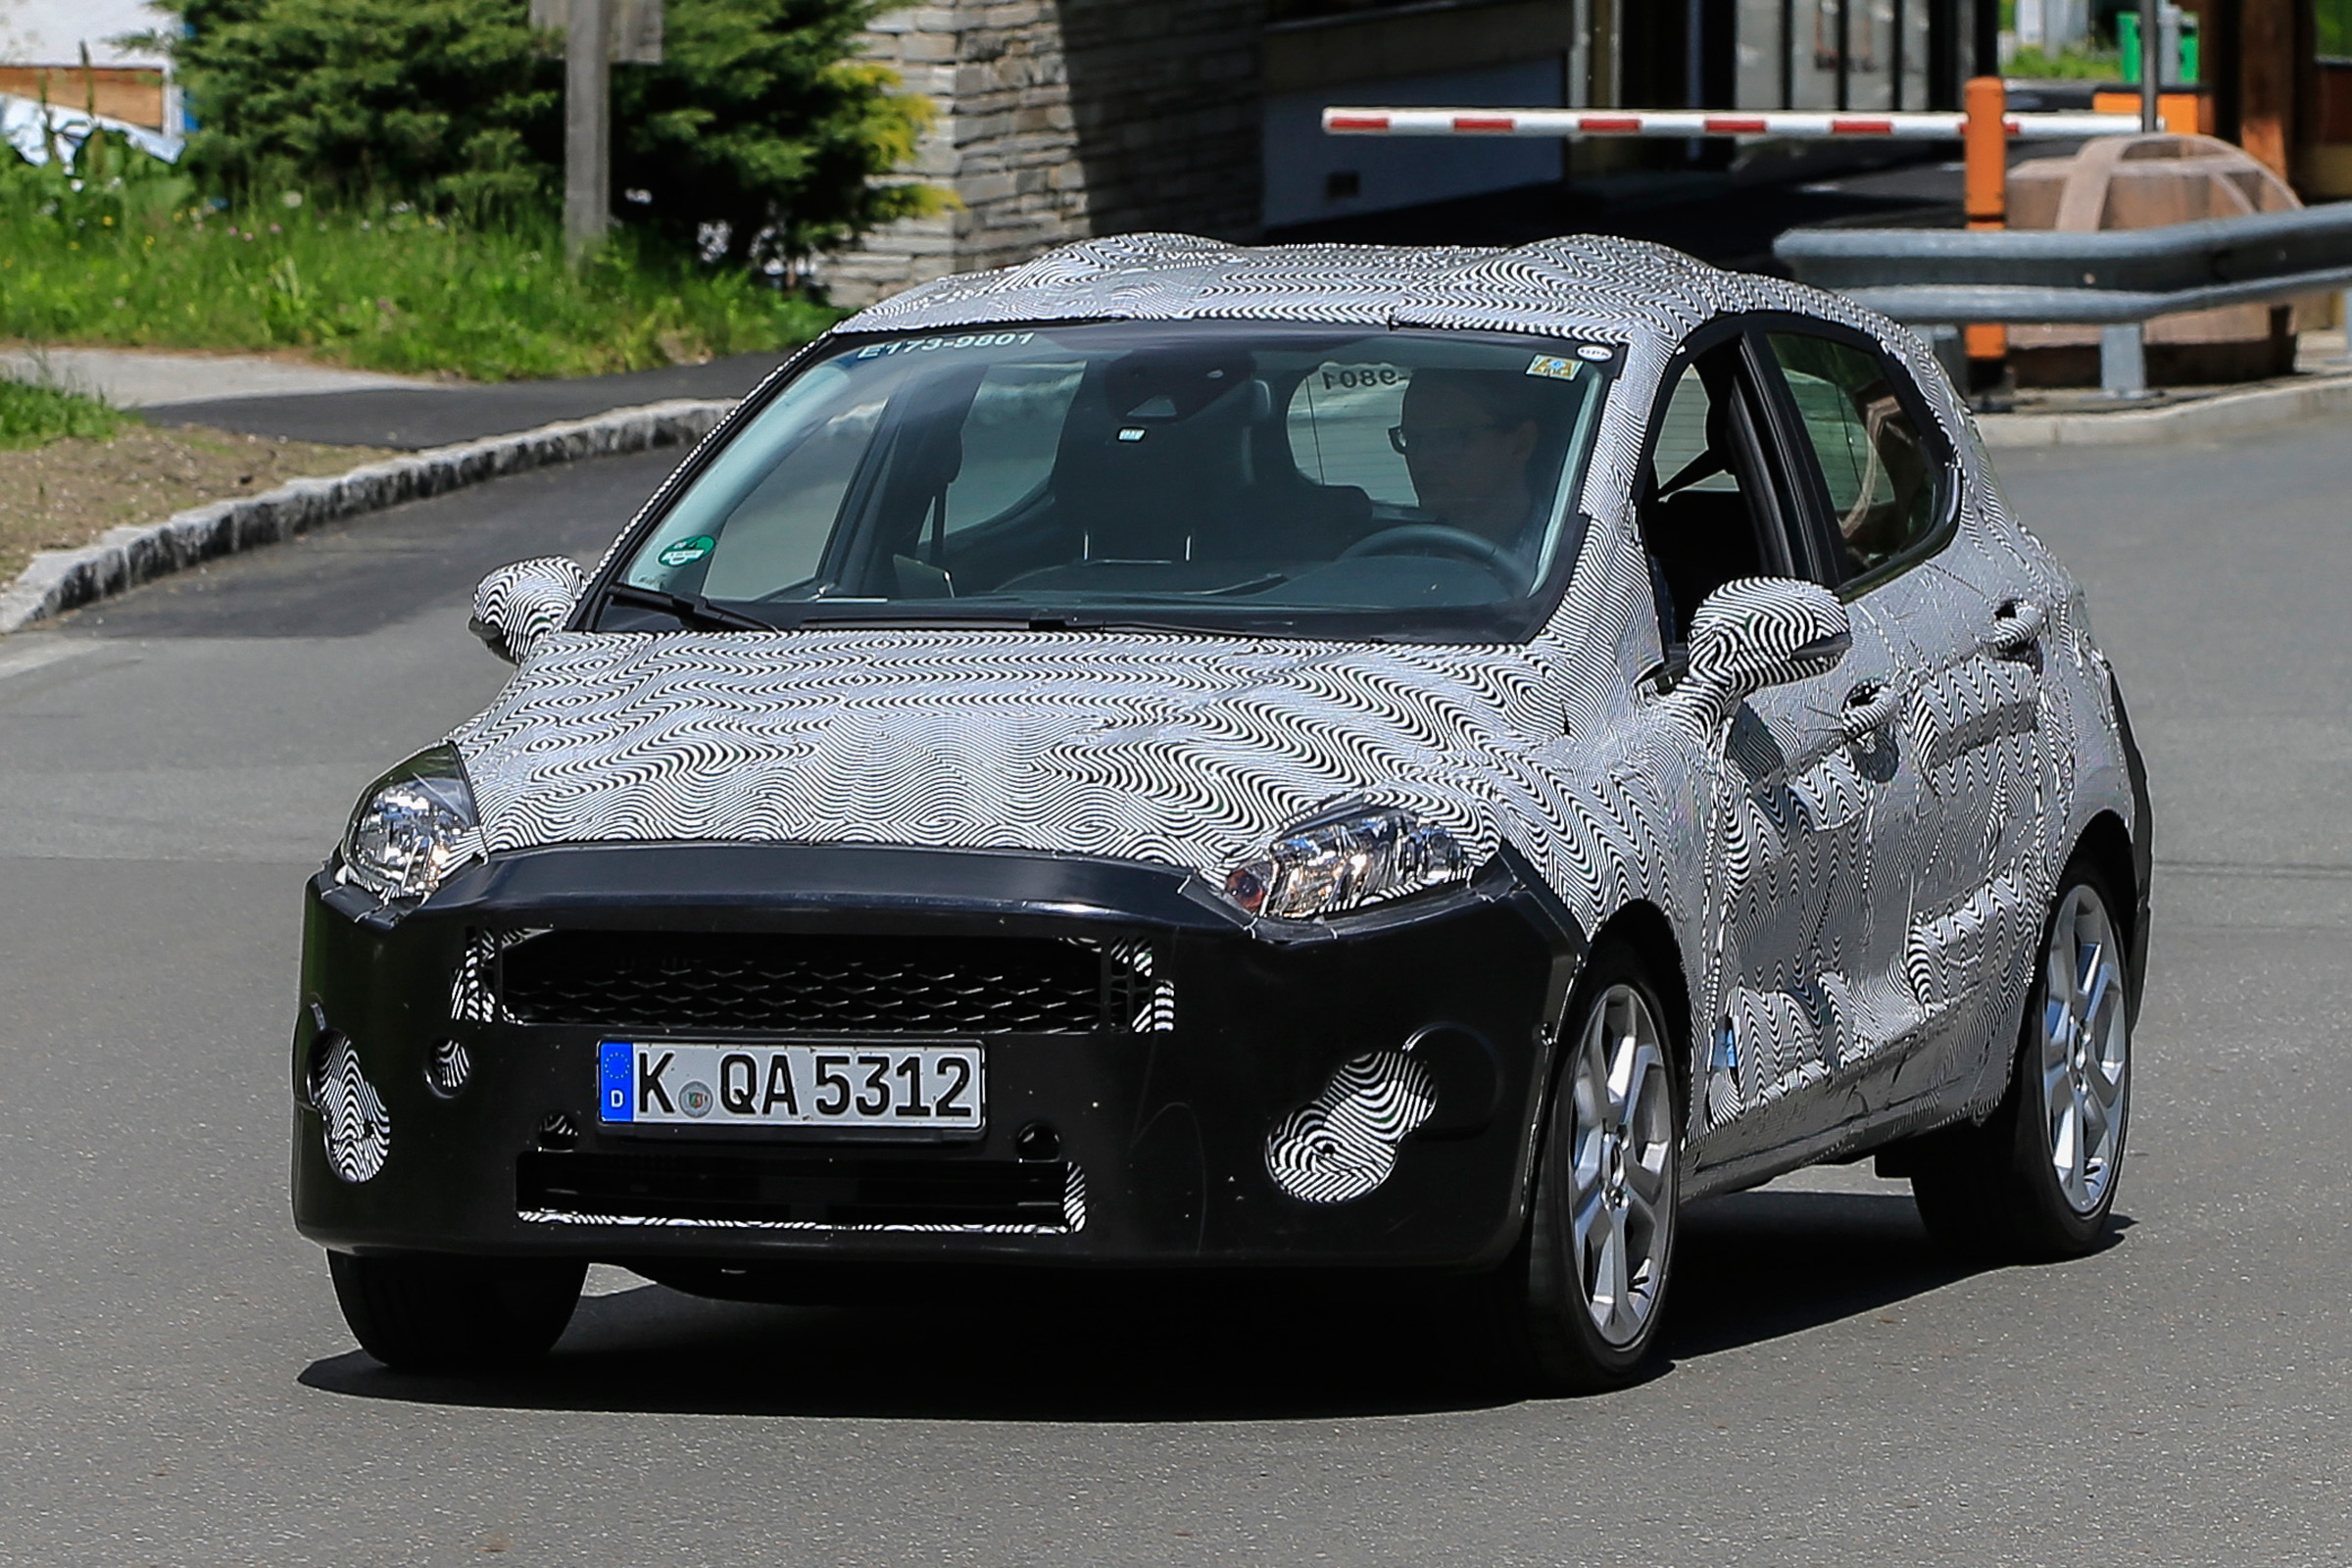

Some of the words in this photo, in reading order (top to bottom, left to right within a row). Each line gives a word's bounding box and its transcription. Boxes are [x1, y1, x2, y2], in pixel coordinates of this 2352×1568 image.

[857, 331, 1035, 360] E173-9801
[611, 1089, 624, 1108] D
[639, 1053, 675, 1113] K
[719, 1054, 799, 1115] QA
[814, 1055, 972, 1117] 5312
